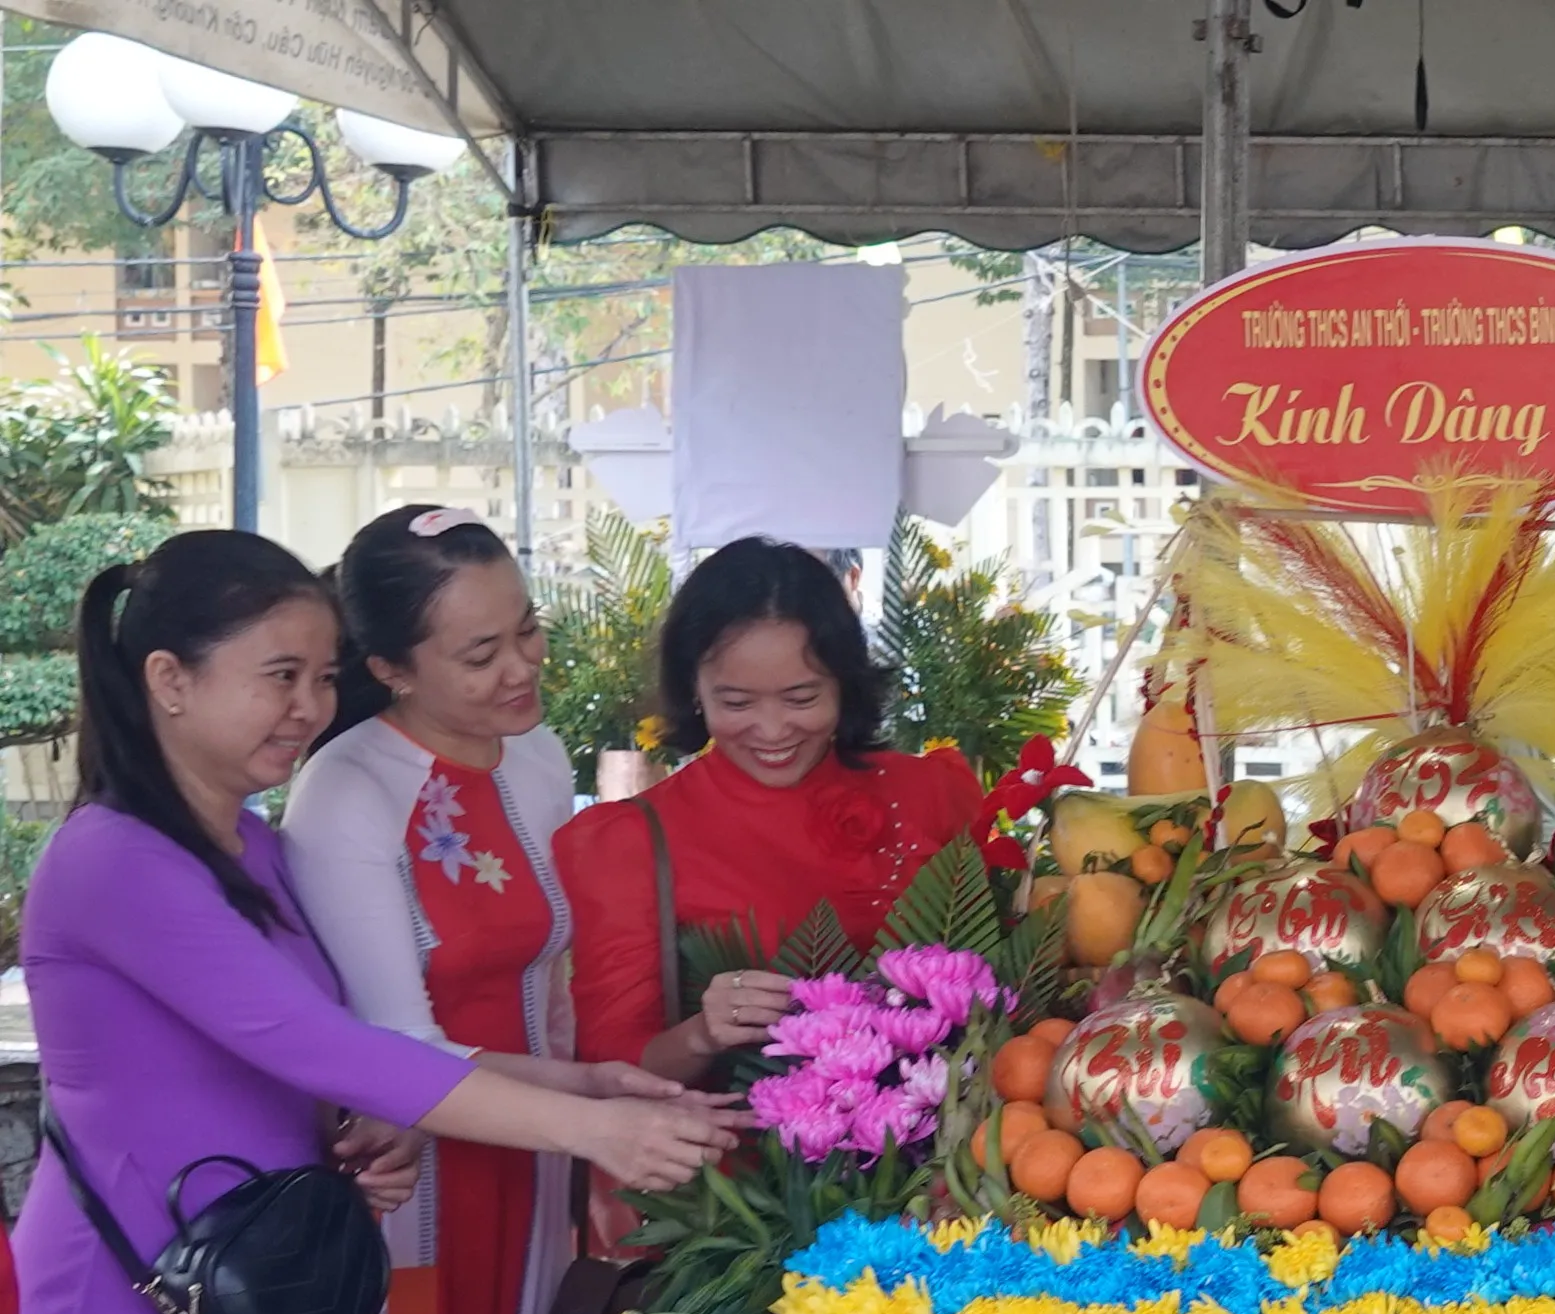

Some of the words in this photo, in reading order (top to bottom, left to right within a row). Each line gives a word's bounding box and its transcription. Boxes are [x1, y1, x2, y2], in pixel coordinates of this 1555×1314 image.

[1242, 300, 1305, 348] TRƯỜNG
[1307, 309, 1349, 348] THCS
[1350, 309, 1372, 347] AN
[1374, 298, 1411, 348] THỚI
[1420, 297, 1484, 346] TRƯỜNG
[1486, 306, 1527, 345] THCS
[1215, 382, 1370, 446] Kính
[1384, 380, 1551, 457] Dâng
